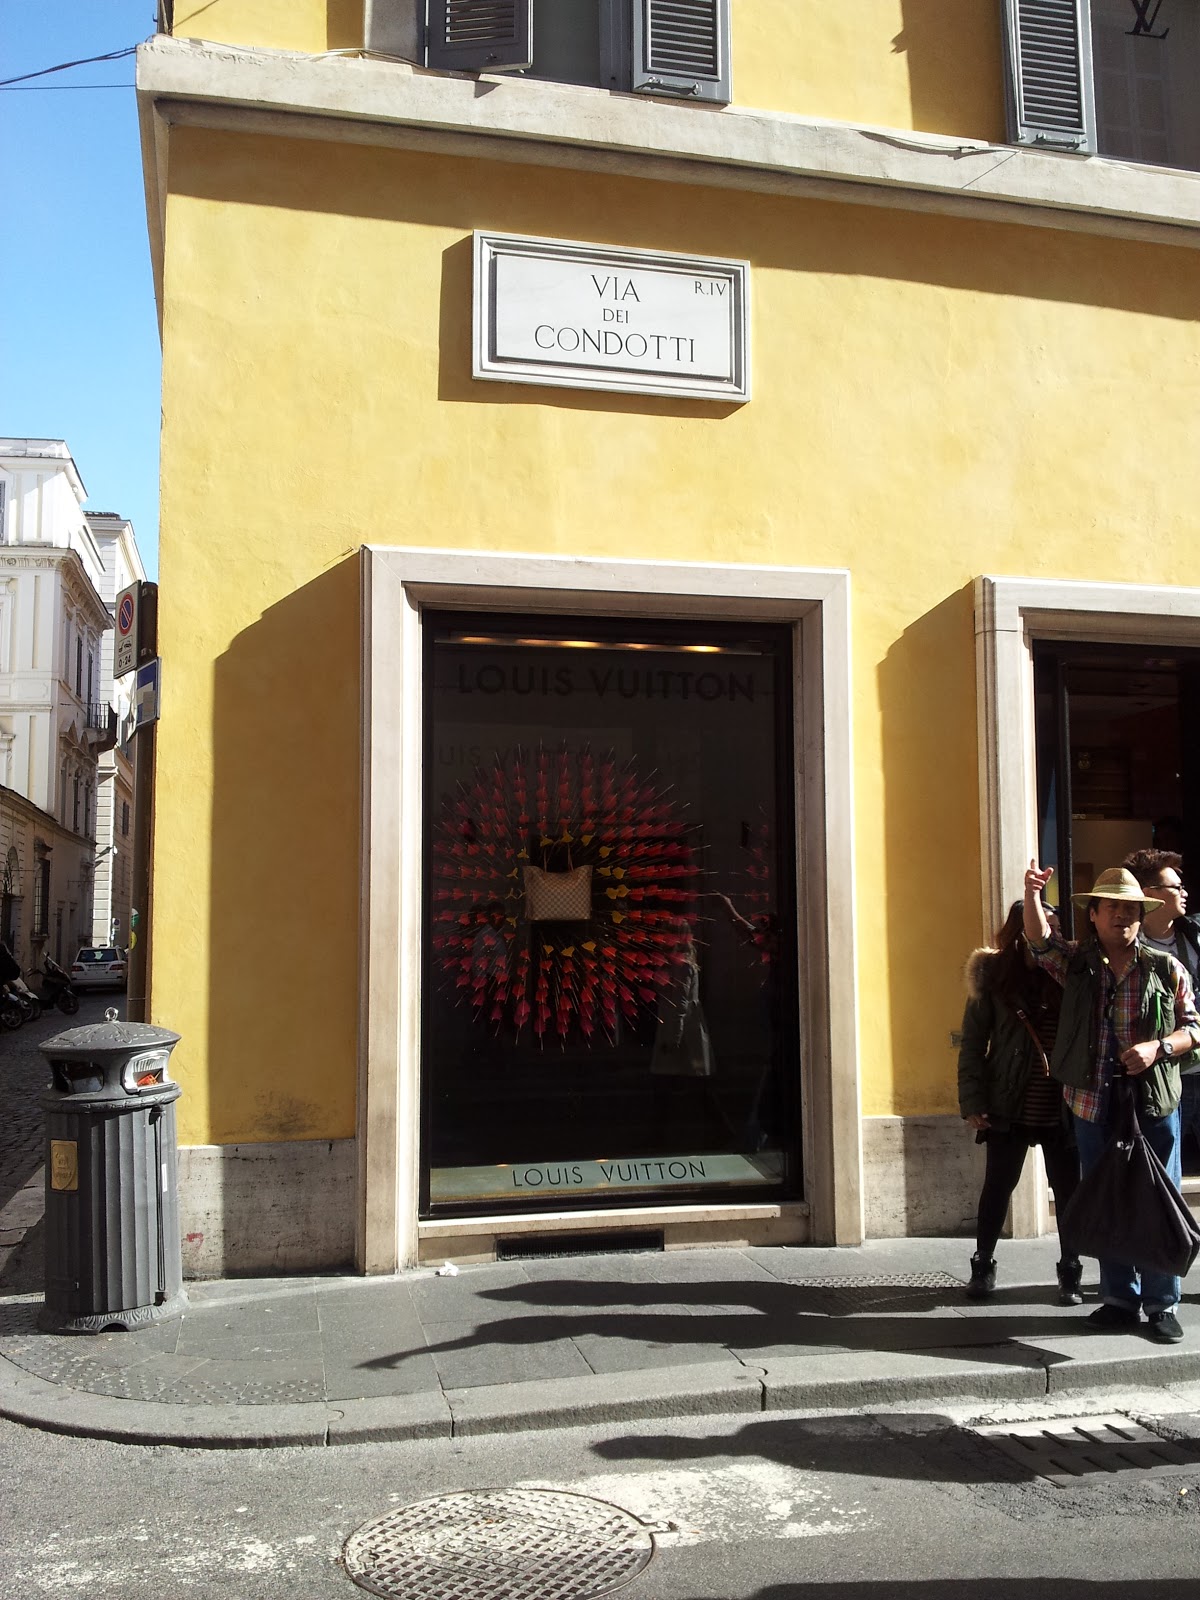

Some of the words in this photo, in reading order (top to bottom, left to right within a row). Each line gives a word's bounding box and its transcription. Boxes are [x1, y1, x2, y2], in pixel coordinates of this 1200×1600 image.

[590, 274, 641, 303] VIA
[602, 307, 629, 324] DEI
[534, 324, 695, 363] CONDOTTI
[457, 664, 575, 696] LOUIS
[589, 668, 755, 702] VUITTON
[512, 1165, 584, 1188] LOUIS
[600, 1160, 706, 1183] VUITTON
